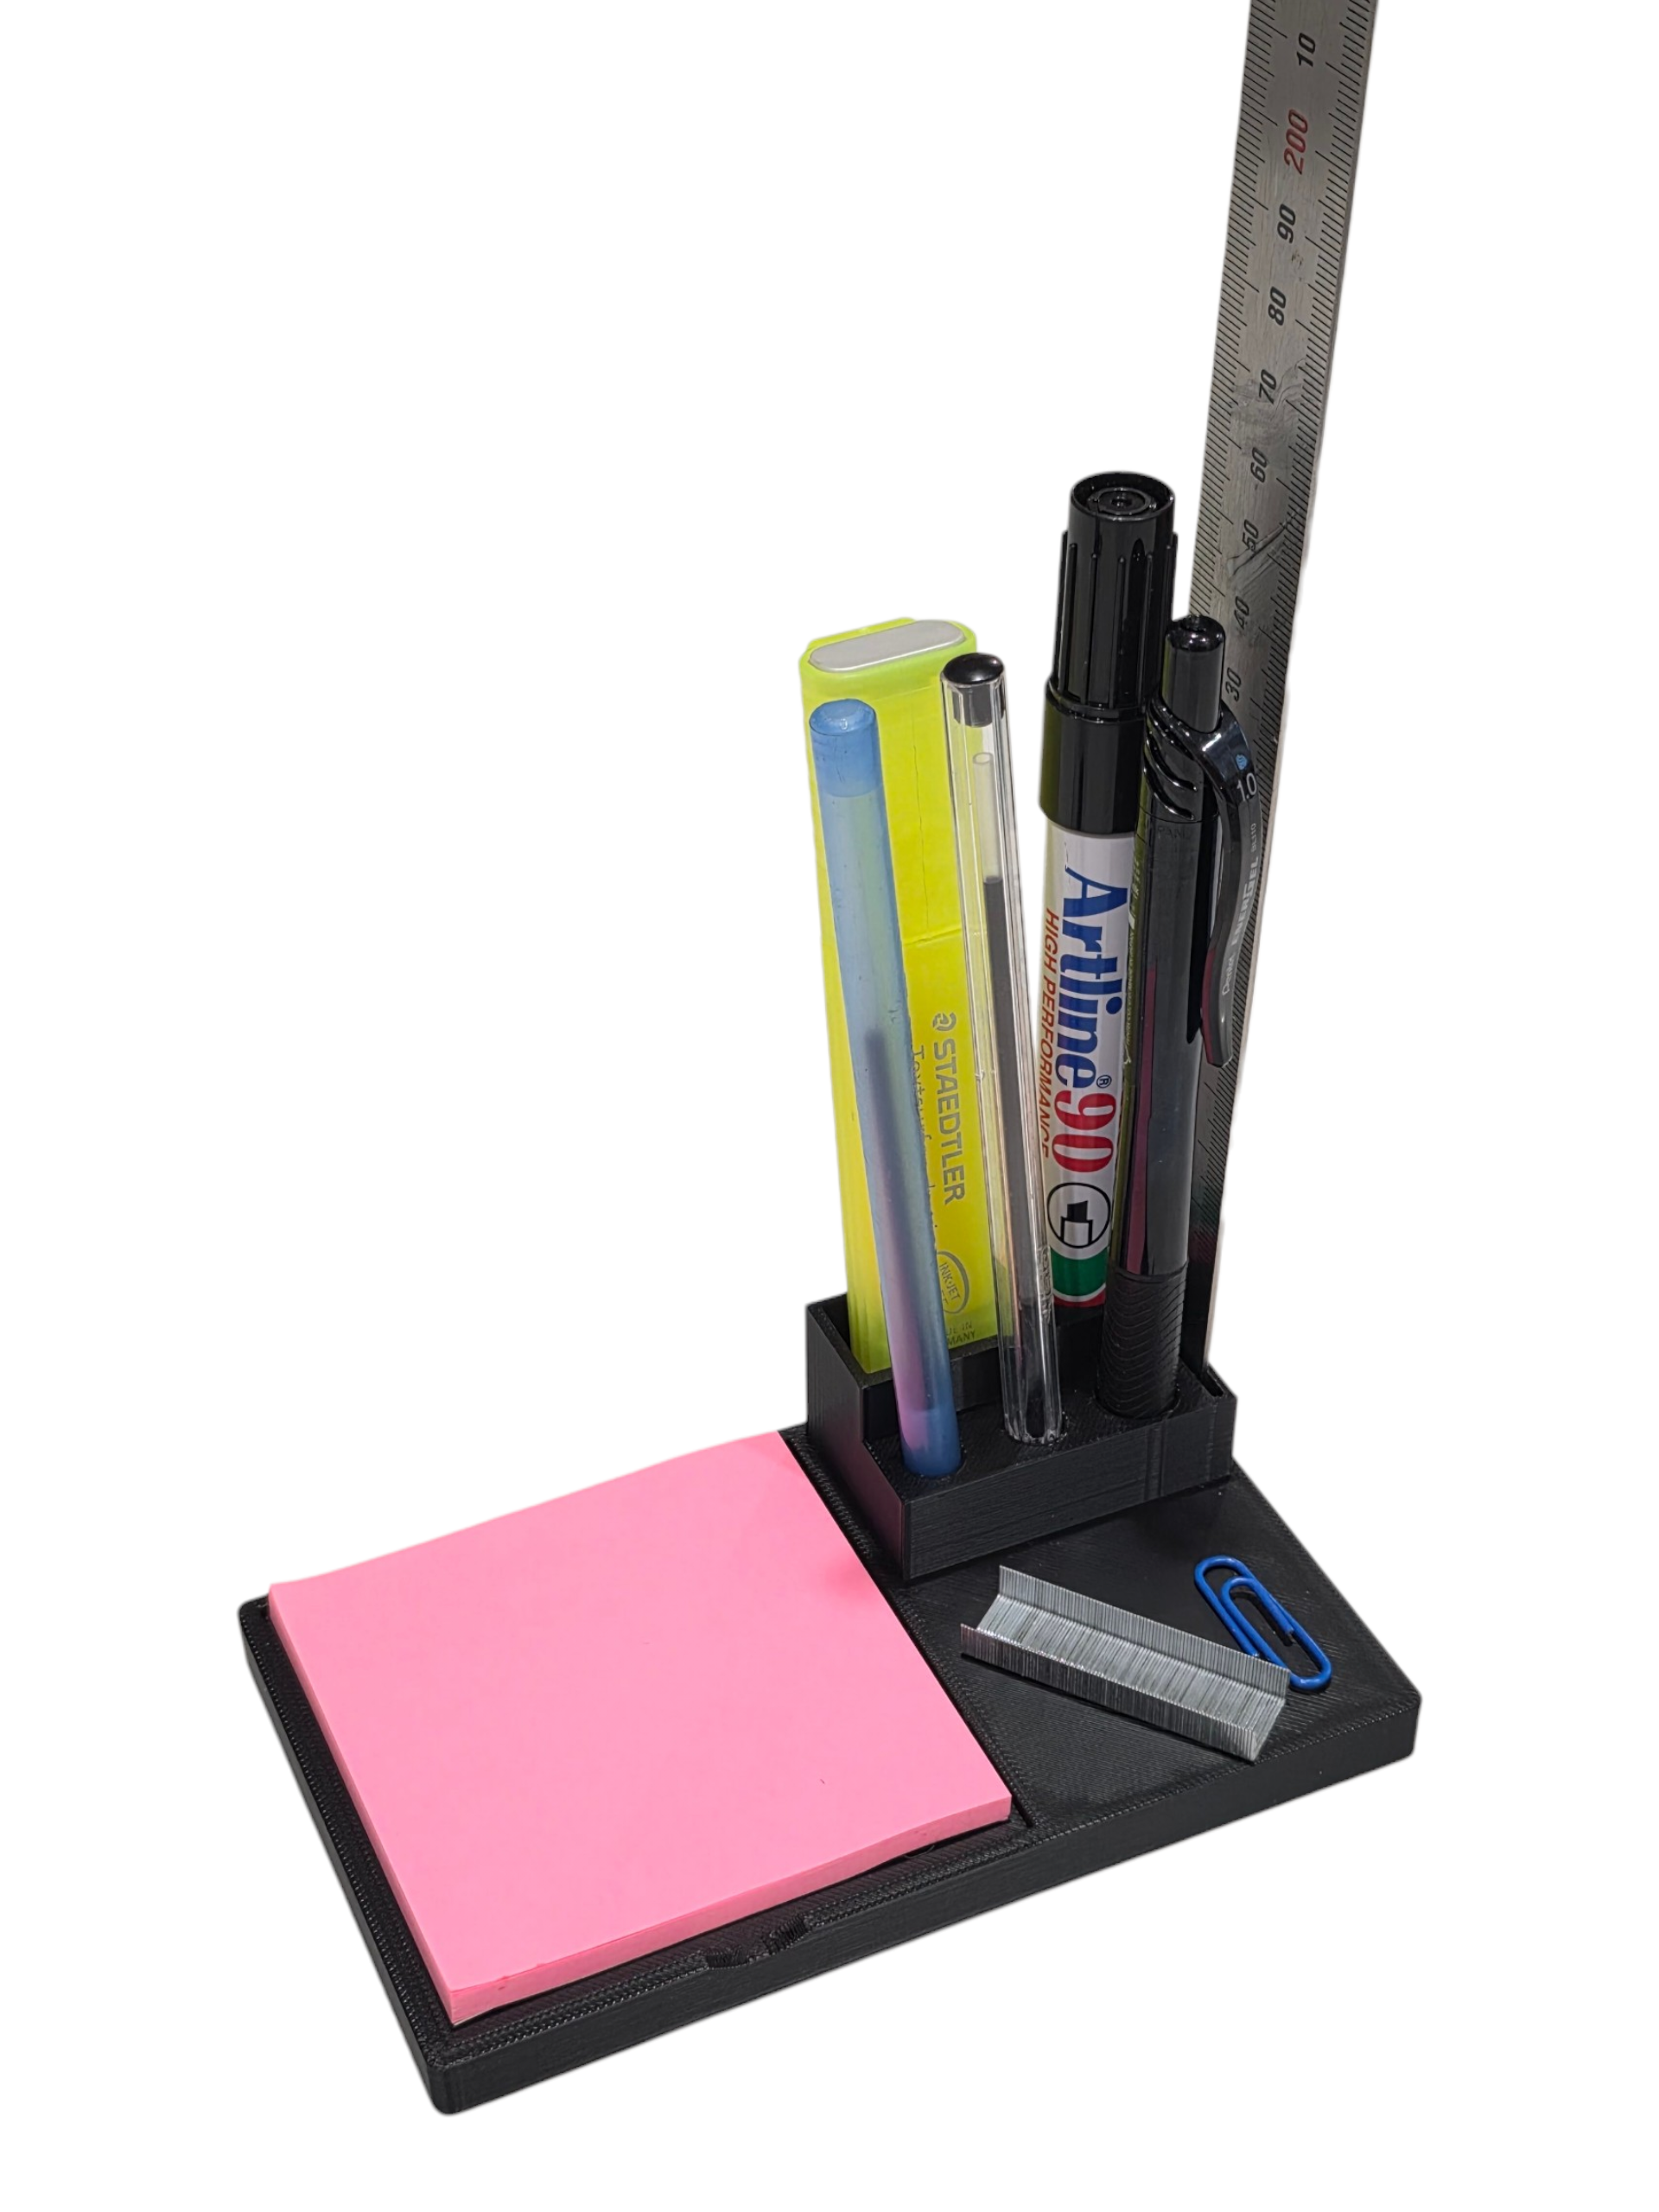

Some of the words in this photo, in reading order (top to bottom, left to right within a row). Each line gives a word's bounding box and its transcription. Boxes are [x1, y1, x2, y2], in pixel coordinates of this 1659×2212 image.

[1296, 33, 1316, 67] 10
[1284, 109, 1308, 175] 200
[1277, 204, 1296, 244] 90
[1268, 287, 1287, 326] 80
[1259, 369, 1276, 404] 70
[1250, 448, 1268, 483] 60
[1242, 519, 1259, 552] 50
[1234, 596, 1249, 630] 40
[1225, 668, 1242, 702] 30
[1045, 908, 1059, 974] HIGH
[933, 1039, 965, 1205] STAEDTLER
